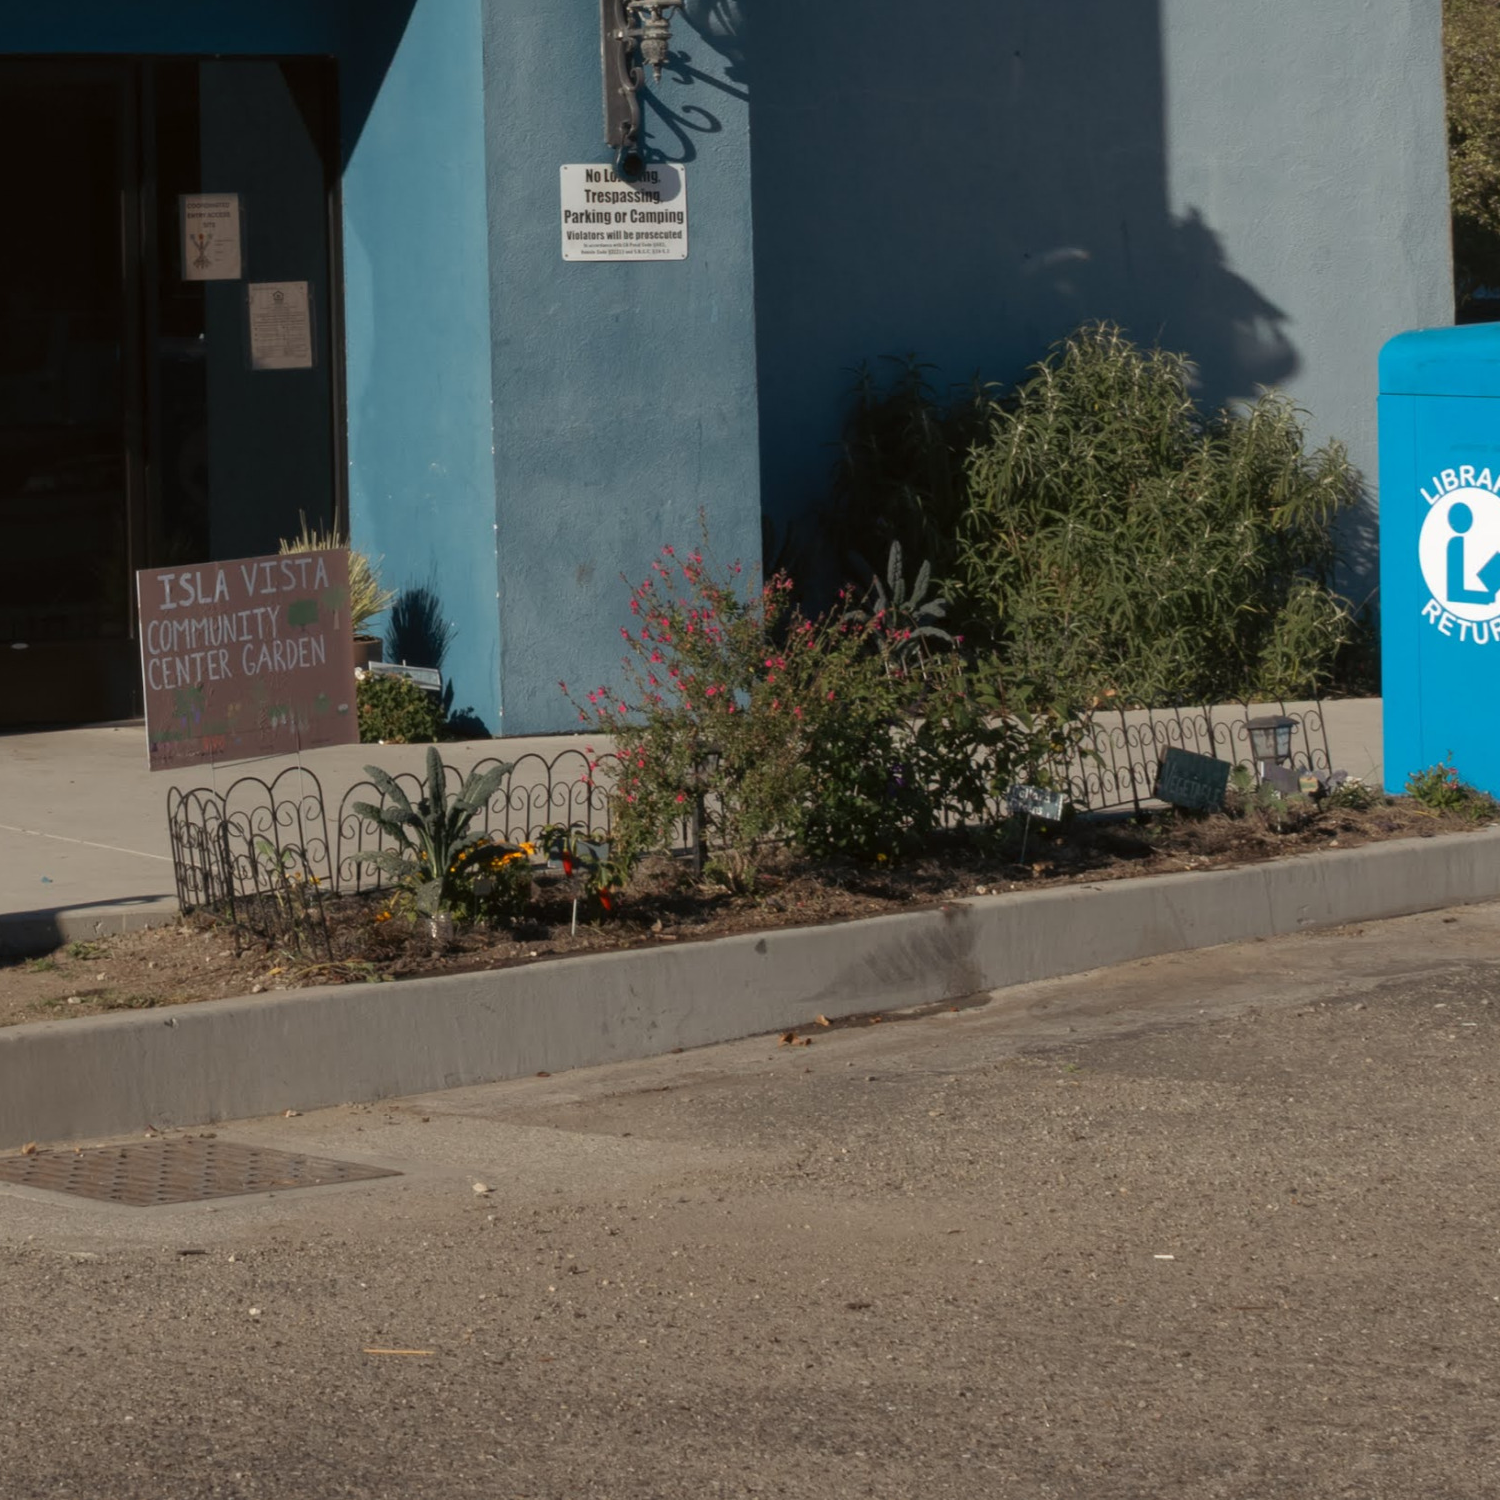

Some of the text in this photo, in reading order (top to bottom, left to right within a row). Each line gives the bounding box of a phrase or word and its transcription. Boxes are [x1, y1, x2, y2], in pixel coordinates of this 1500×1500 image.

[585, 169, 601, 183] No
[564, 209, 684, 225] Parking or Camping
[566, 230, 682, 241] Violators will be prosecuted
[157, 557, 329, 610] ISLA VISTA
[147, 606, 281, 655] COMMUNITY
[148, 634, 326, 691] CENTER GARDEN
